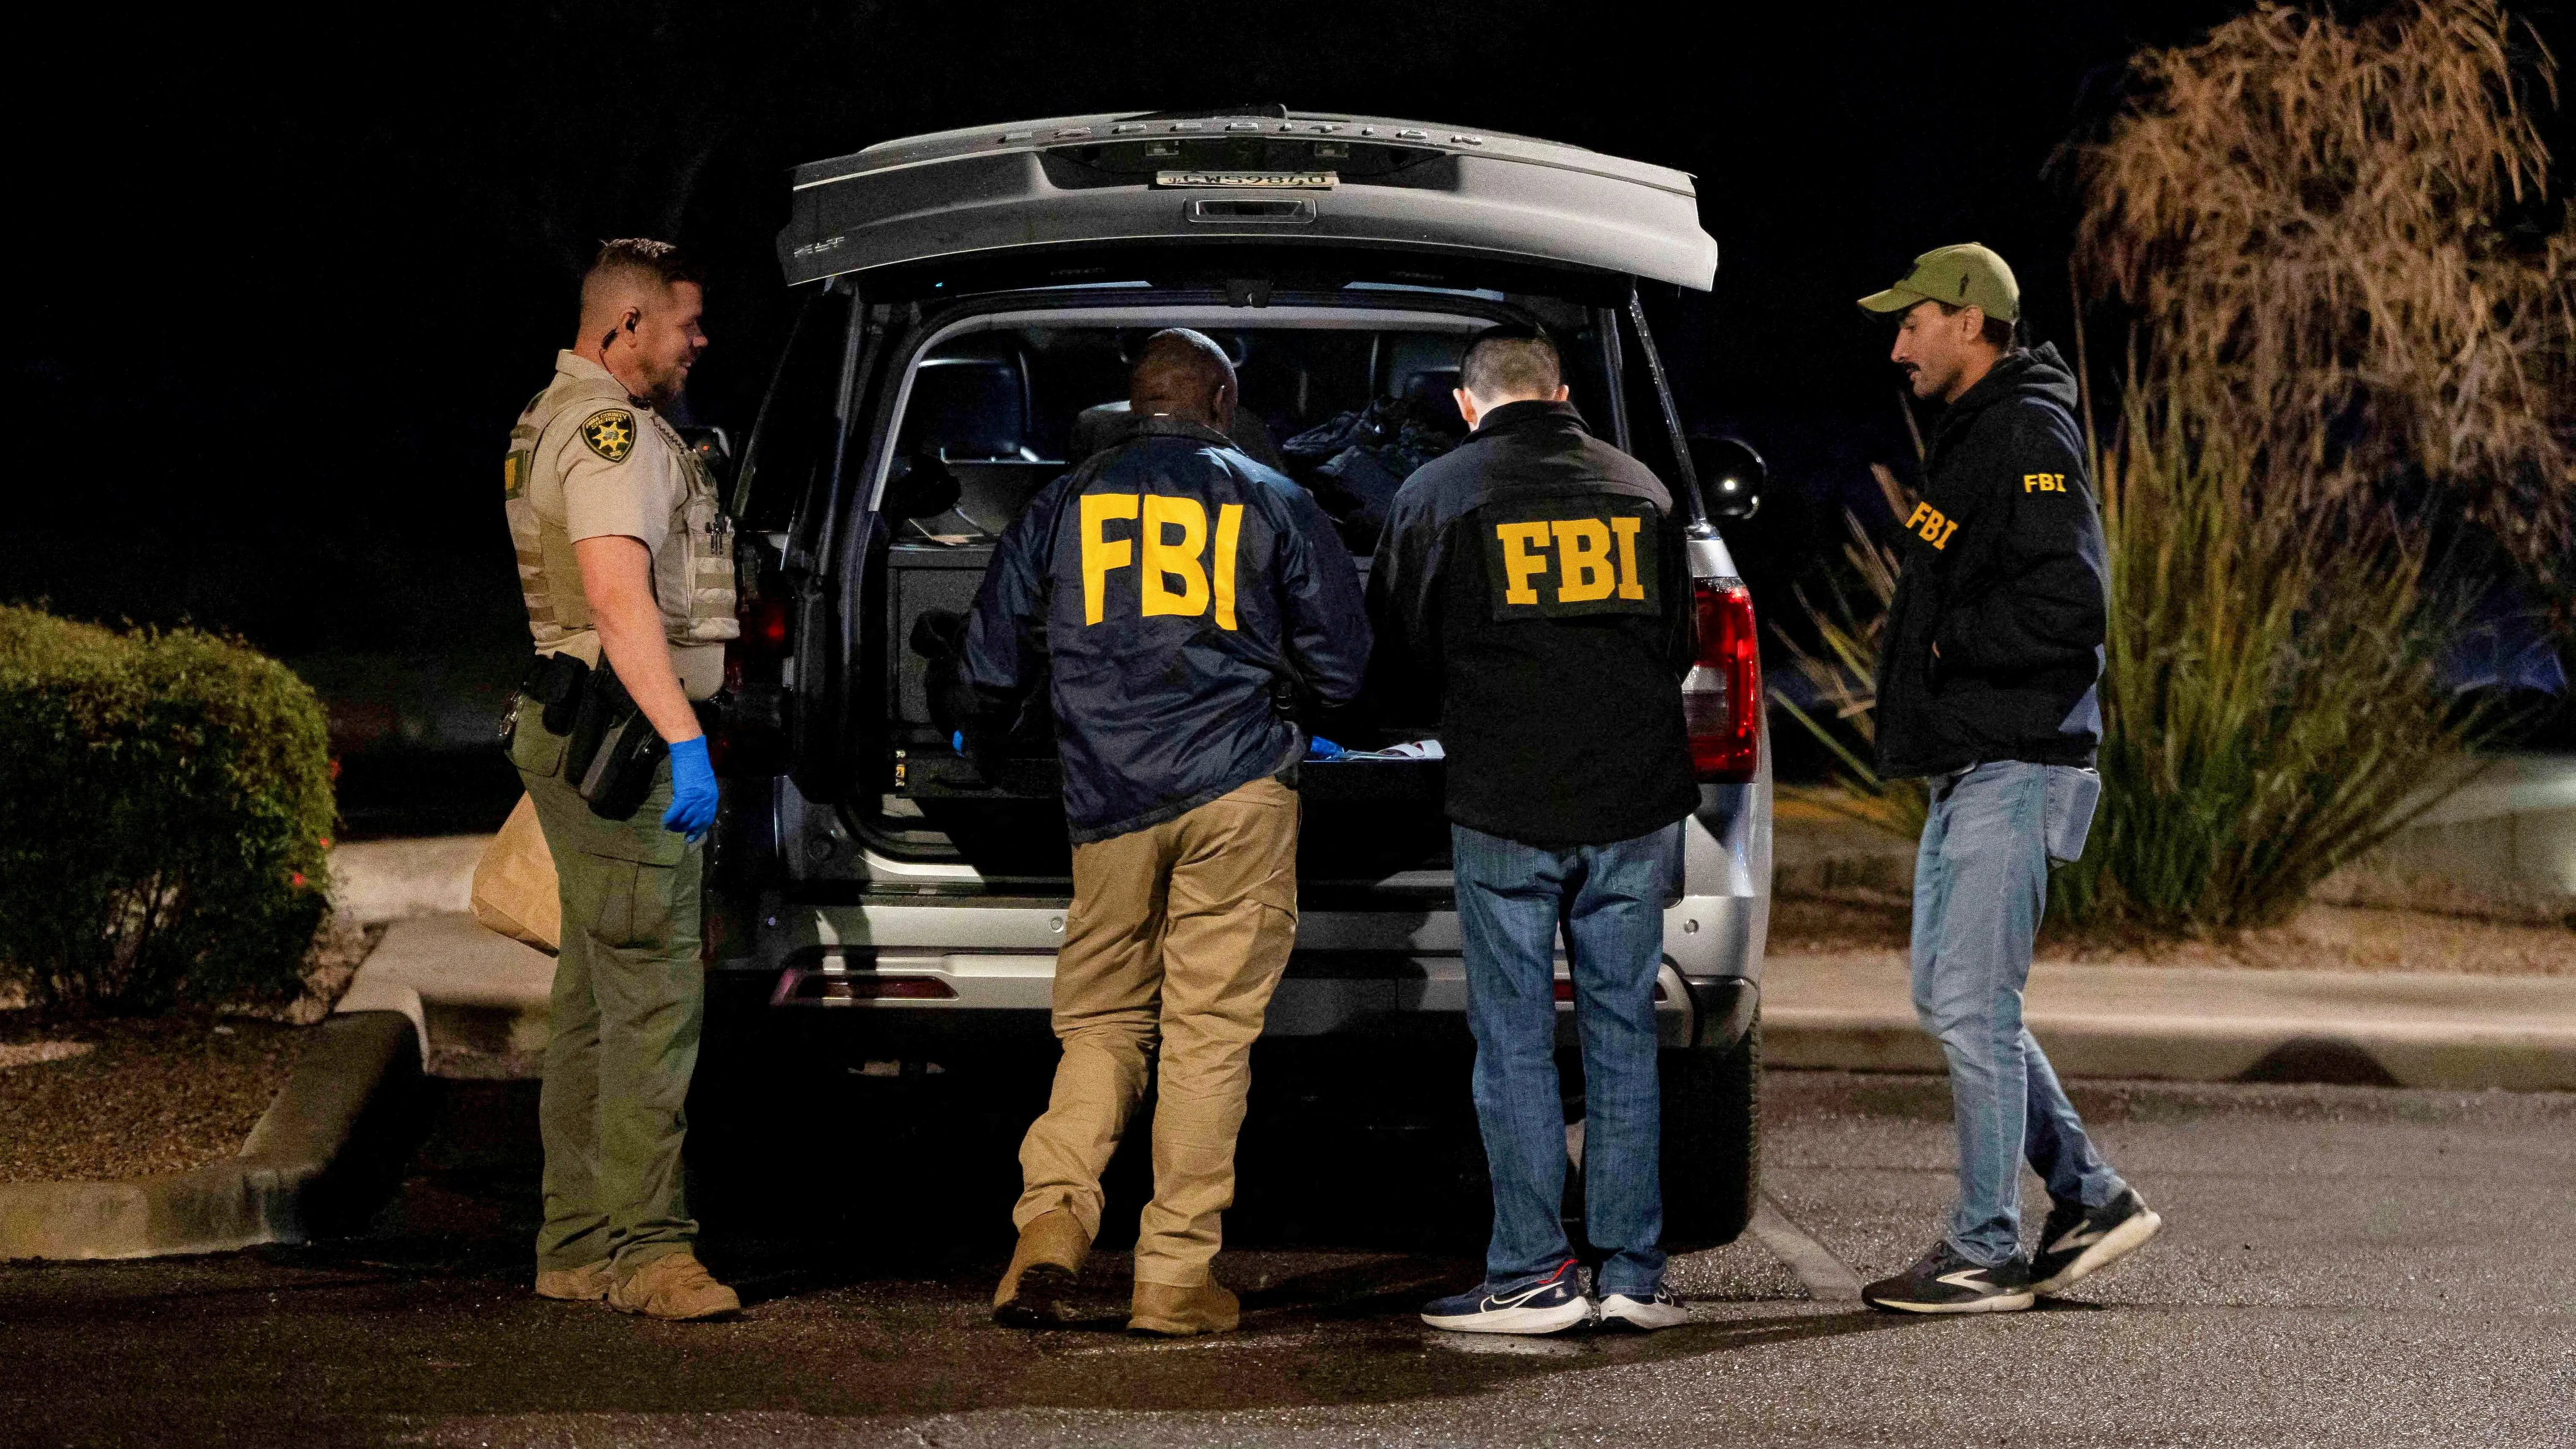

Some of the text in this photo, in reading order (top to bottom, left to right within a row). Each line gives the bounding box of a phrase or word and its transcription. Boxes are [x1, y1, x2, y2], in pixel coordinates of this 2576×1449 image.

[2023, 473, 2067, 493] FBI
[1905, 501, 1958, 550] FBI
[1080, 493, 1244, 631] FBI
[1496, 517, 1644, 605] FBI
